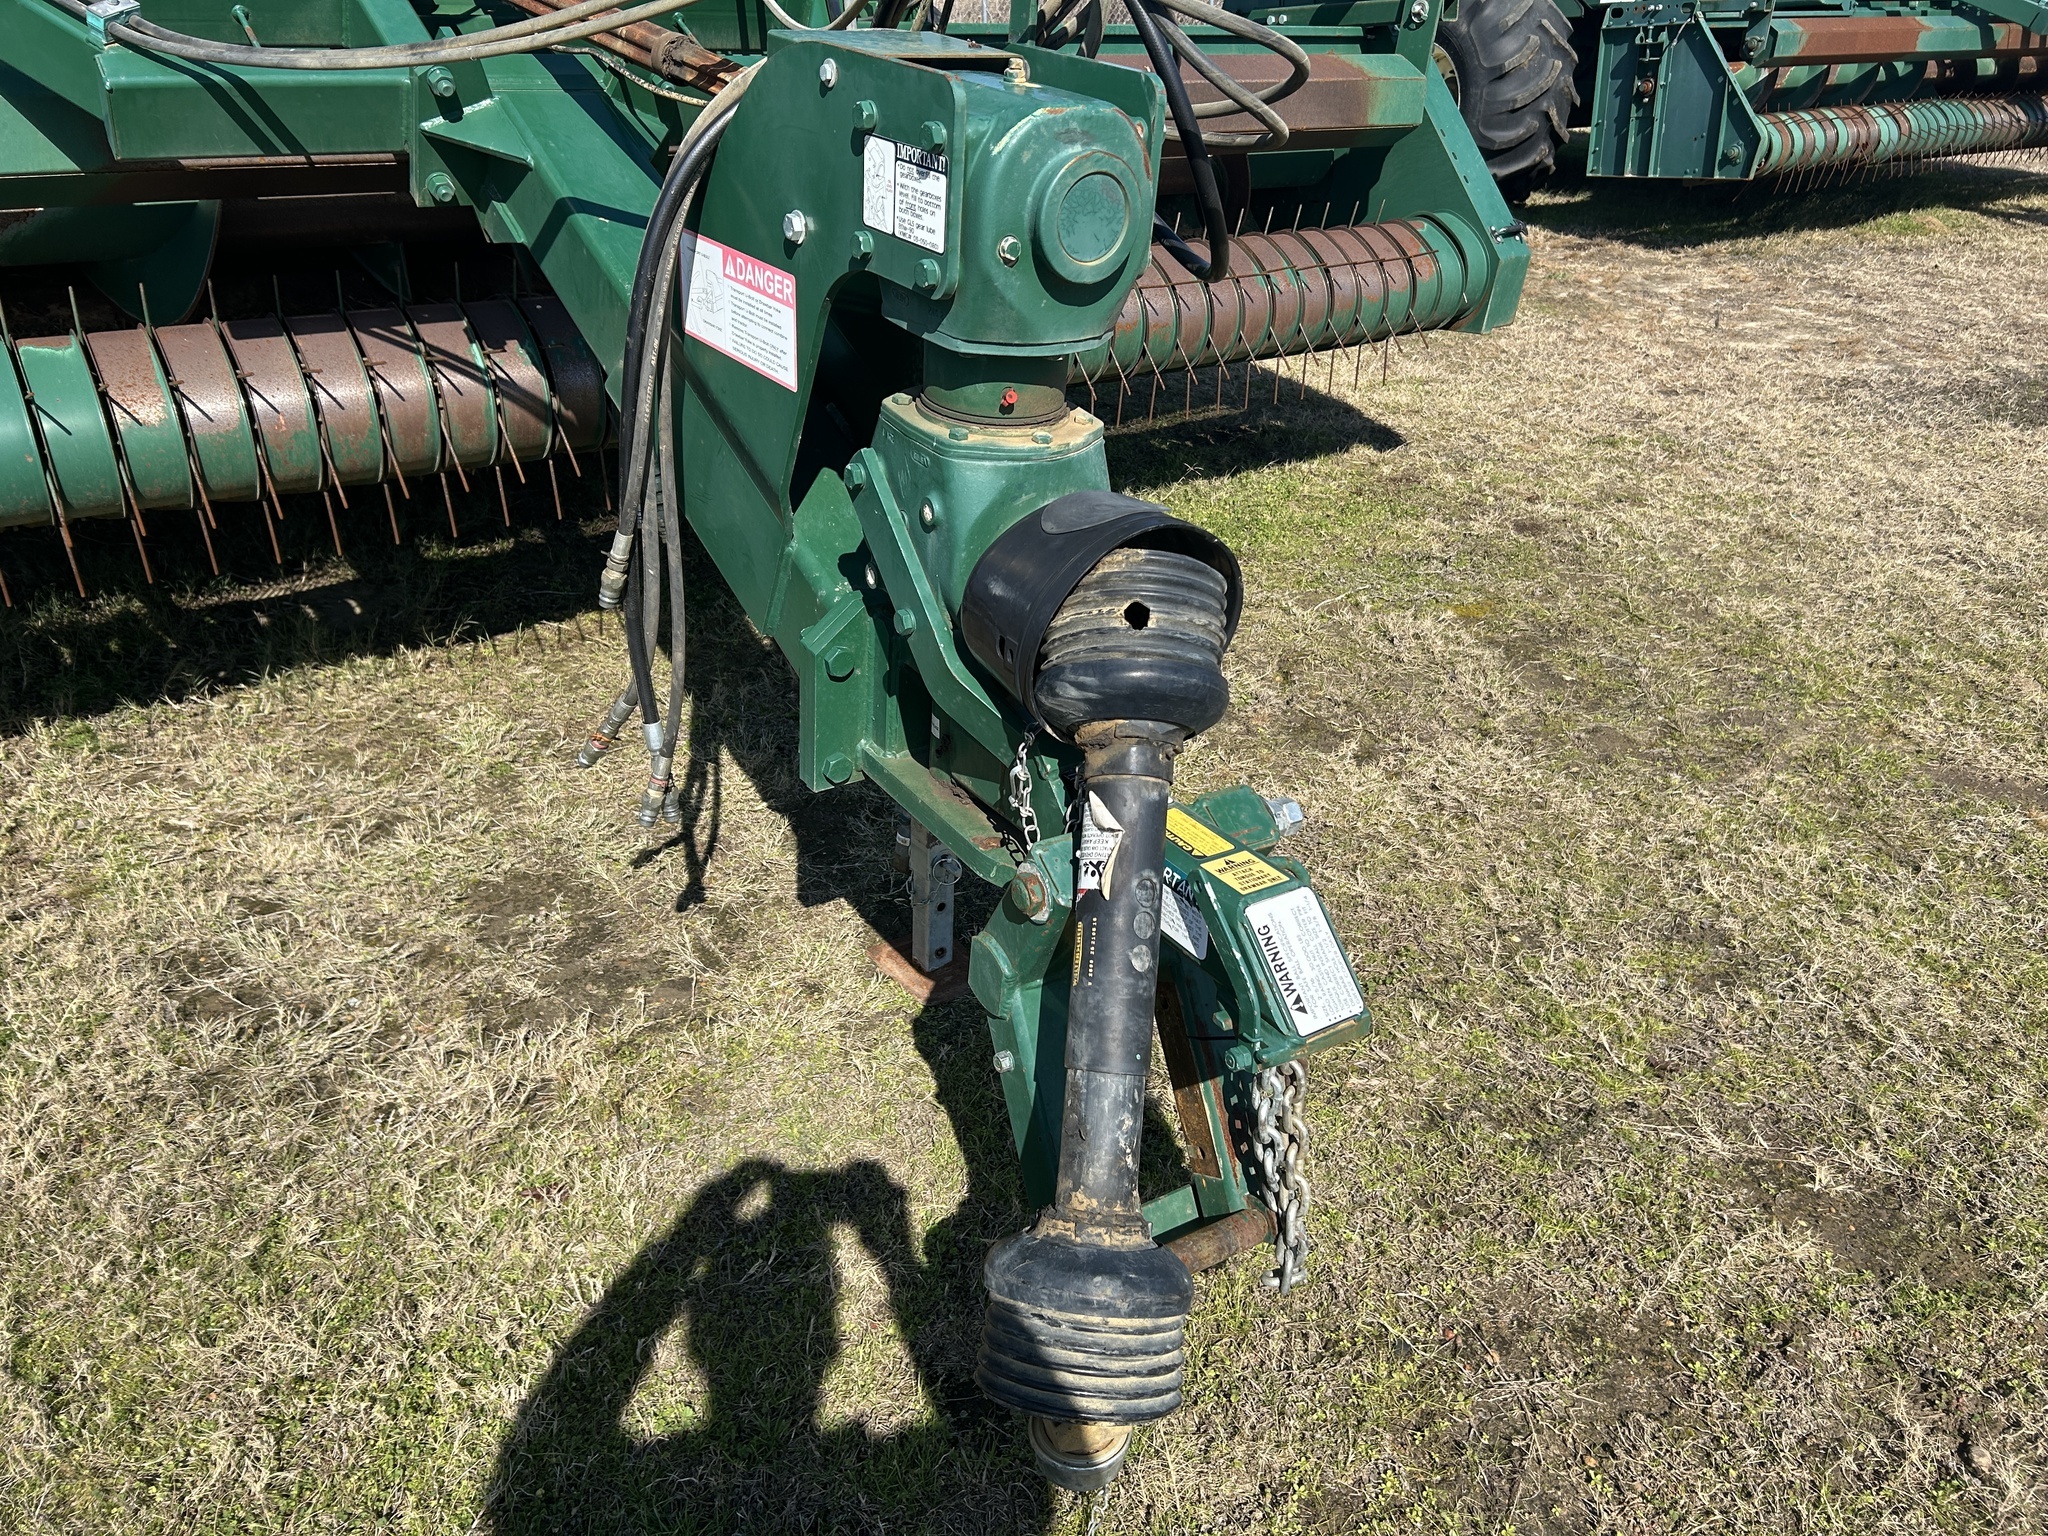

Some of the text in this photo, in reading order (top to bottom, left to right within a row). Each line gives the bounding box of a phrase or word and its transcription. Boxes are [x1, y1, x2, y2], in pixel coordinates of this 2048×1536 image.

[897, 143, 946, 172] IMPORTANT!
[932, 174, 940, 182] the
[900, 183, 910, 191] With
[920, 190, 941, 203] gearboxes
[899, 207, 909, 215] both
[918, 205, 928, 214] holes
[924, 200, 941, 211] bottom
[916, 223, 925, 232] gear
[926, 226, 935, 235] lube
[736, 256, 793, 304] DANGER
[1215, 859, 1256, 873] WARNING
[1231, 868, 1254, 876] ATTACH
[1237, 873, 1272, 886] STATIONARY
[1239, 875, 1282, 891] DRAWBAR ONLY
[1306, 916, 1313, 925] TO
[1301, 918, 1315, 942] COTTER
[1311, 927, 1320, 939] SIZE
[1313, 944, 1326, 967] INSTALL
[1317, 941, 1330, 963] SHANK
[1257, 925, 1297, 997] WARNING
[1267, 912, 1318, 1020] IMPORTANT BALL SPECIFICATIONS
[1290, 907, 1340, 1013] TIGHTEN CASTLE NUT TO CORRECT
[1294, 960, 1304, 974] BALL
[1323, 968, 1333, 983] AND
[1328, 965, 1345, 996] CORRECT
[1301, 977, 1311, 992] SAFE
[1339, 975, 1356, 1007] DRAWBAR
[1309, 994, 1318, 1008] FOR
[1324, 998, 1335, 1015] LOAD
[1342, 998, 1351, 1009] USE
